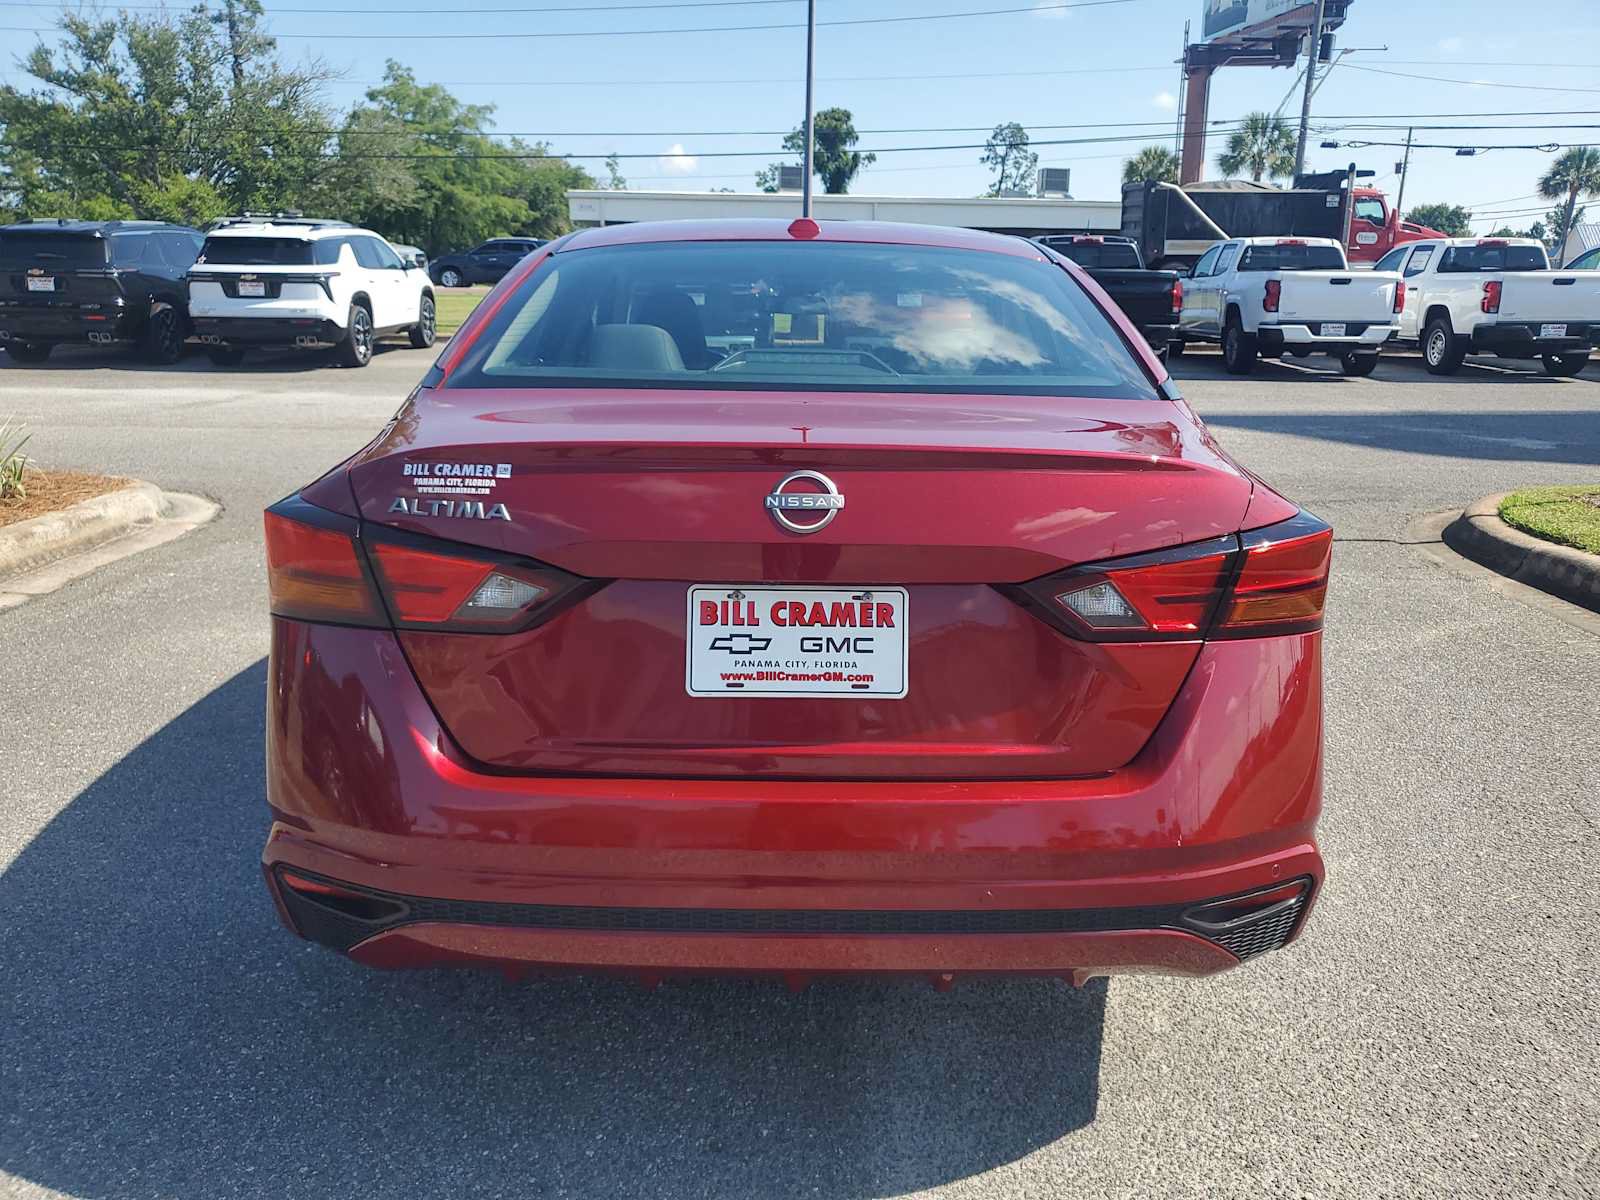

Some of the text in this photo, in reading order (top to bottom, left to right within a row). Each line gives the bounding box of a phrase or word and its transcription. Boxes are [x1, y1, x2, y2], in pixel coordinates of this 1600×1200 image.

[403, 463, 430, 476] BILL
[434, 463, 493, 477] CRAMER
[413, 478, 445, 486] PANAMA
[464, 479, 496, 487] FLORIDA
[766, 496, 842, 507] NISSAN
[388, 497, 512, 521] ALTIMA
[700, 600, 895, 628] BILL CRAMER
[800, 637, 874, 654] GMC
[734, 660, 858, 669] PANAMA CITY, FLORIDA
[720, 671, 874, 683] www.BillCramerGM.com
